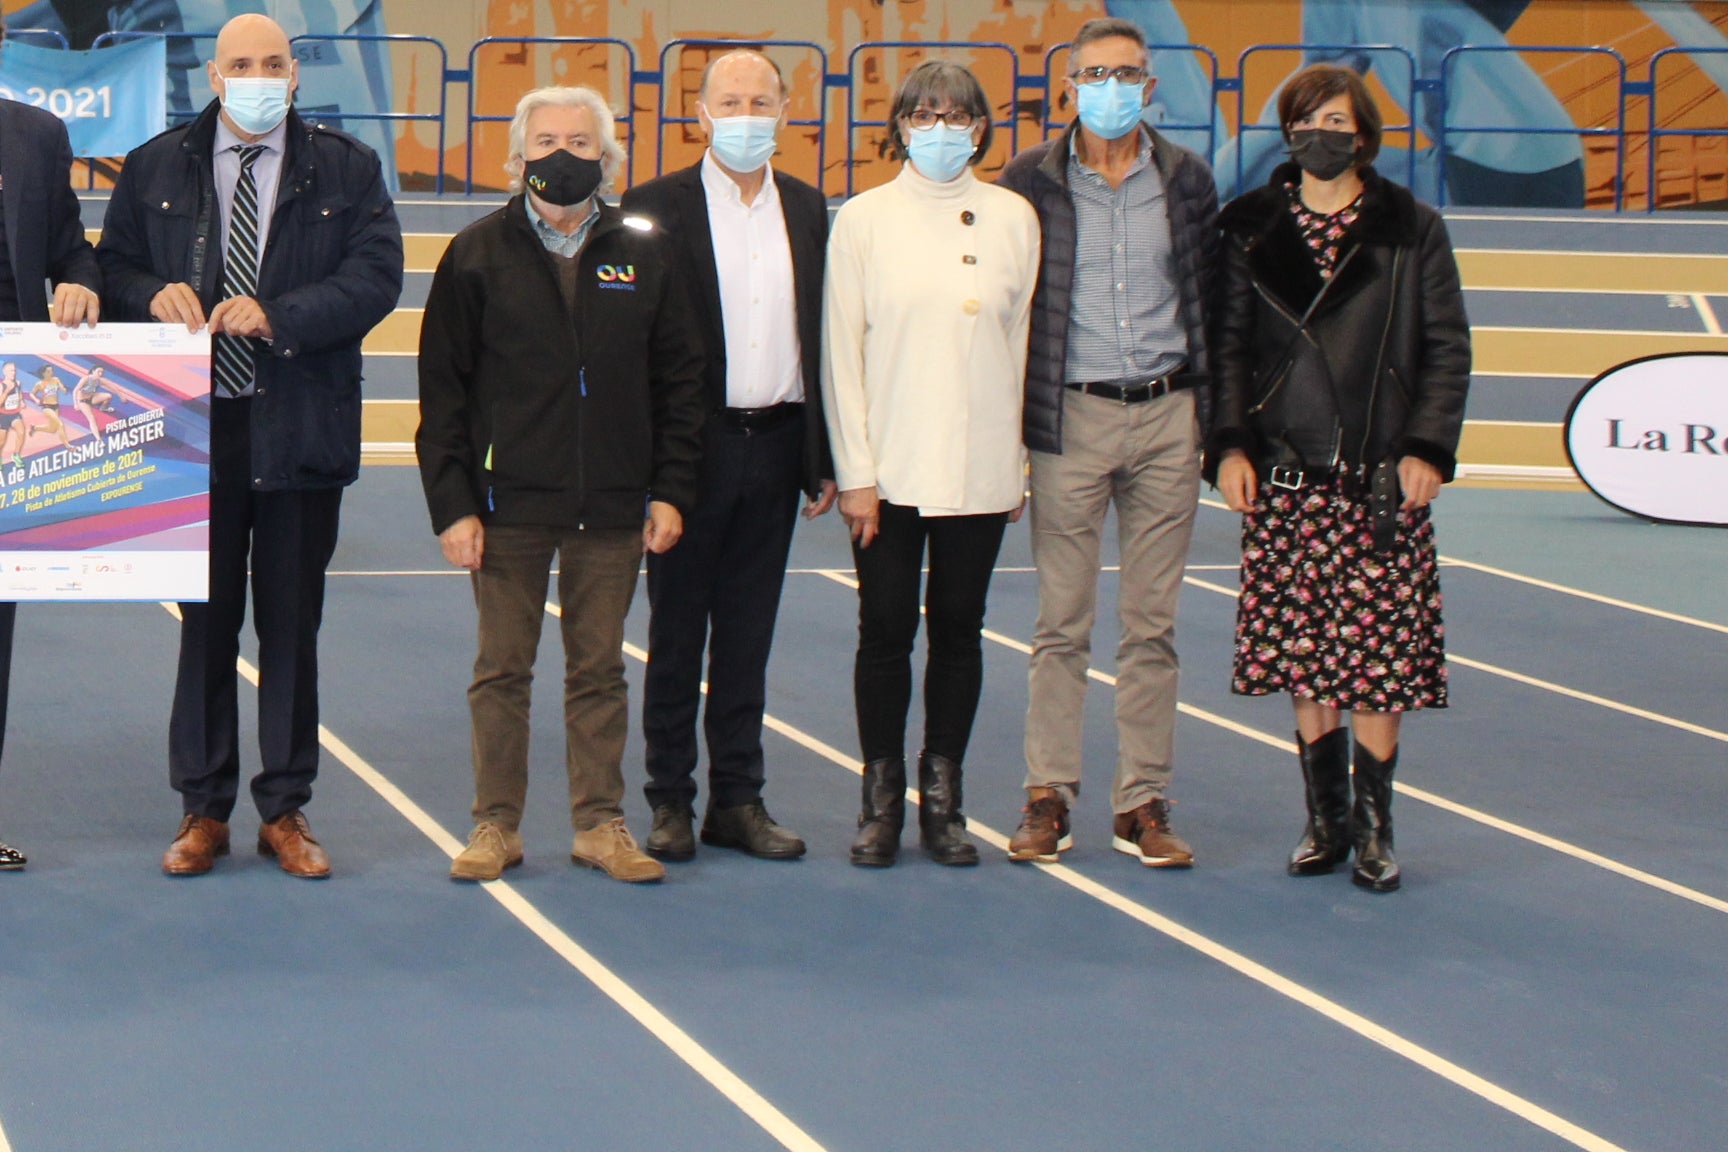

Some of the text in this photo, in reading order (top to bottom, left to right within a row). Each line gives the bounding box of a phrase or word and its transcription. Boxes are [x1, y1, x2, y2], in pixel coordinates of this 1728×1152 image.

[26, 86, 111, 118] 2021
[596, 264, 636, 282] OU
[106, 409, 165, 434] PISTA CUBIERTA
[1606, 419, 1728, 456] La R
[8, 467, 25, 485] de
[108, 420, 165, 454] MASTER
[11, 487, 26, 505] 28
[27, 483, 41, 500] de
[43, 467, 100, 494] noviembre
[102, 459, 116, 475] de
[118, 449, 144, 470] 2021
[25, 464, 156, 513] Pista de Atletismo Cubierta de Ourense
[100, 481, 144, 502] EXPOURENSE
